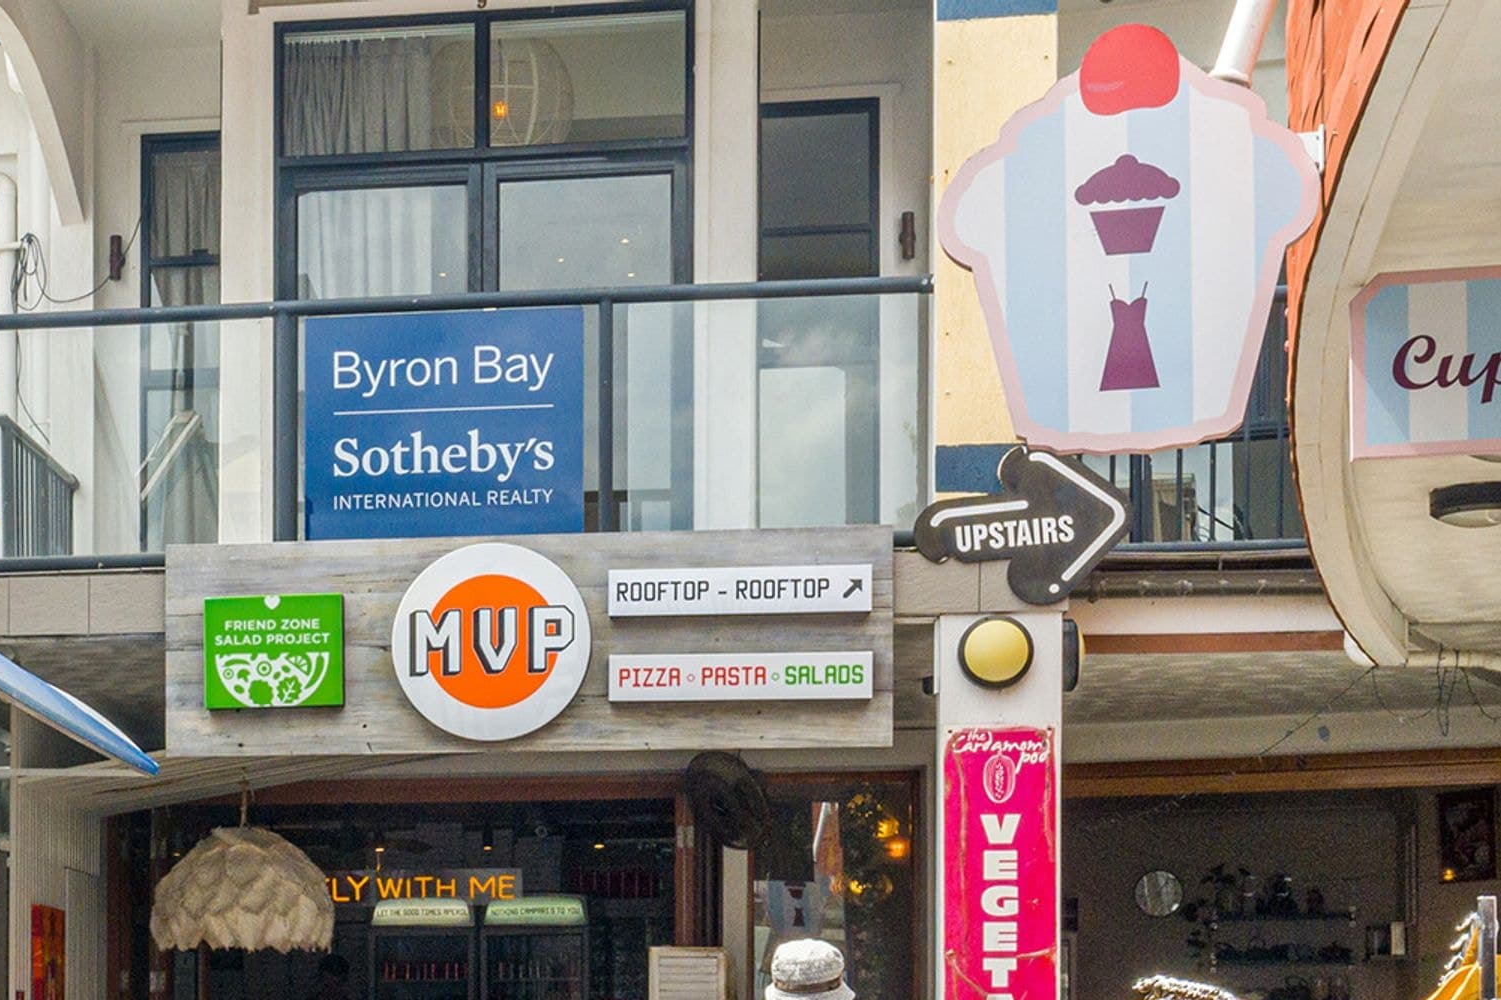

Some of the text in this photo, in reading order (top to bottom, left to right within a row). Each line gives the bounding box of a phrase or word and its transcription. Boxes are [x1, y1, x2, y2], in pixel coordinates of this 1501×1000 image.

[333, 344, 555, 398] Byron Bay
[333, 428, 555, 483] Sotheby's
[333, 488, 554, 511] INTERNATIONAL REALTY
[955, 514, 1075, 553] UPSTAIRS
[616, 580, 710, 602] ROOFTOP
[735, 578, 830, 600] ROOFTOP
[224, 617, 320, 632] FRIEND ZONE
[214, 632, 331, 647] SALAD PROJECT
[410, 604, 575, 677] MVP
[618, 664, 864, 688] PIZZA PASTA SALADS
[377, 875, 456, 899] WITH
[469, 874, 517, 900] ME
